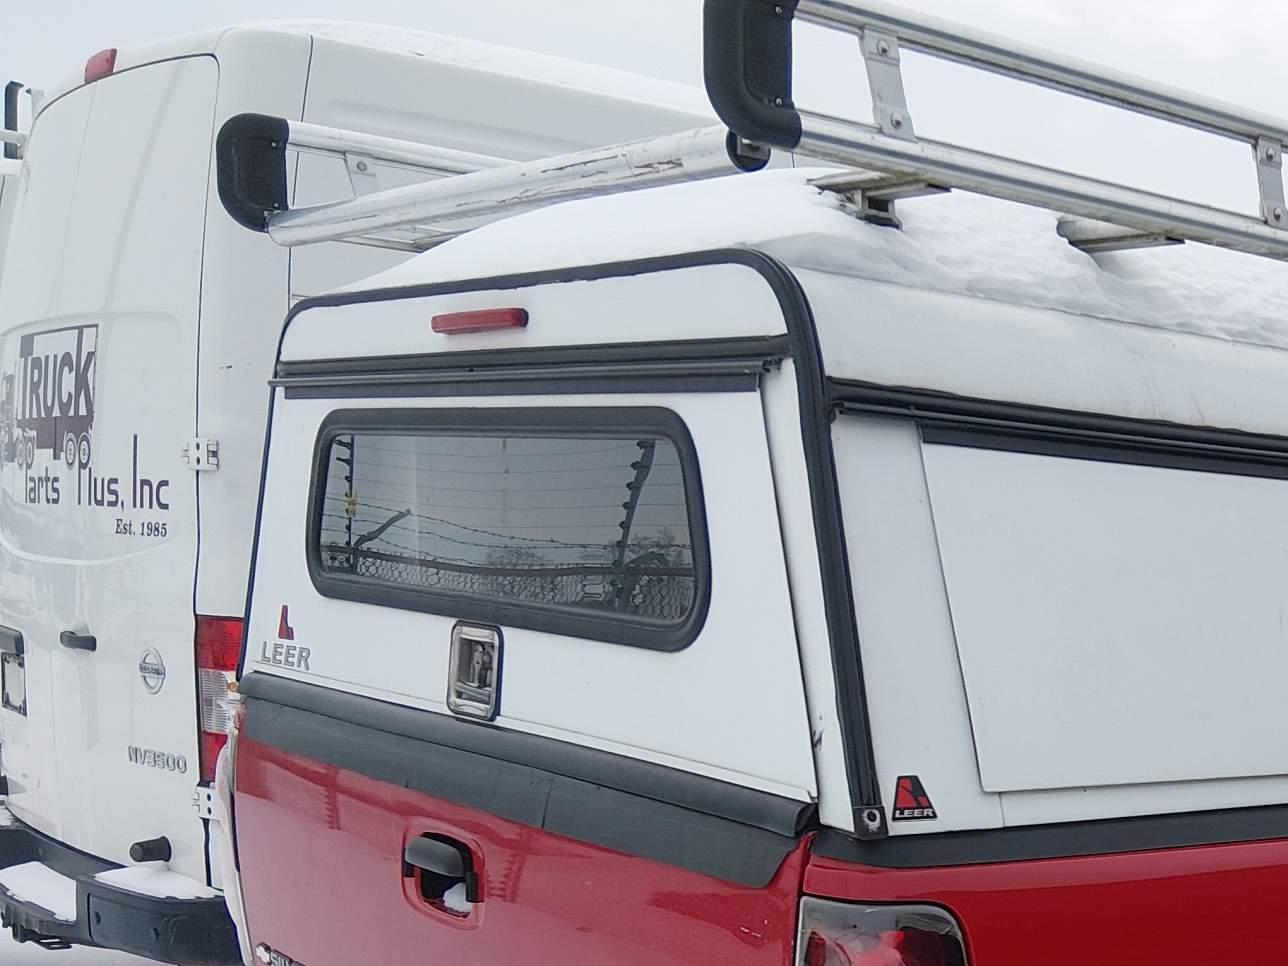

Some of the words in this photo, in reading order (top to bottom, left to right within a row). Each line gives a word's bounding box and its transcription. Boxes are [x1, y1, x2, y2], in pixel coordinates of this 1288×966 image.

[17, 326, 95, 420] TRUCK
[132, 434, 169, 510] Inc
[115, 518, 136, 536] Est.
[140, 521, 167, 538] 1985
[261, 641, 311, 671] LEER
[127, 745, 188, 774] NV3500
[894, 808, 934, 818] LEER
